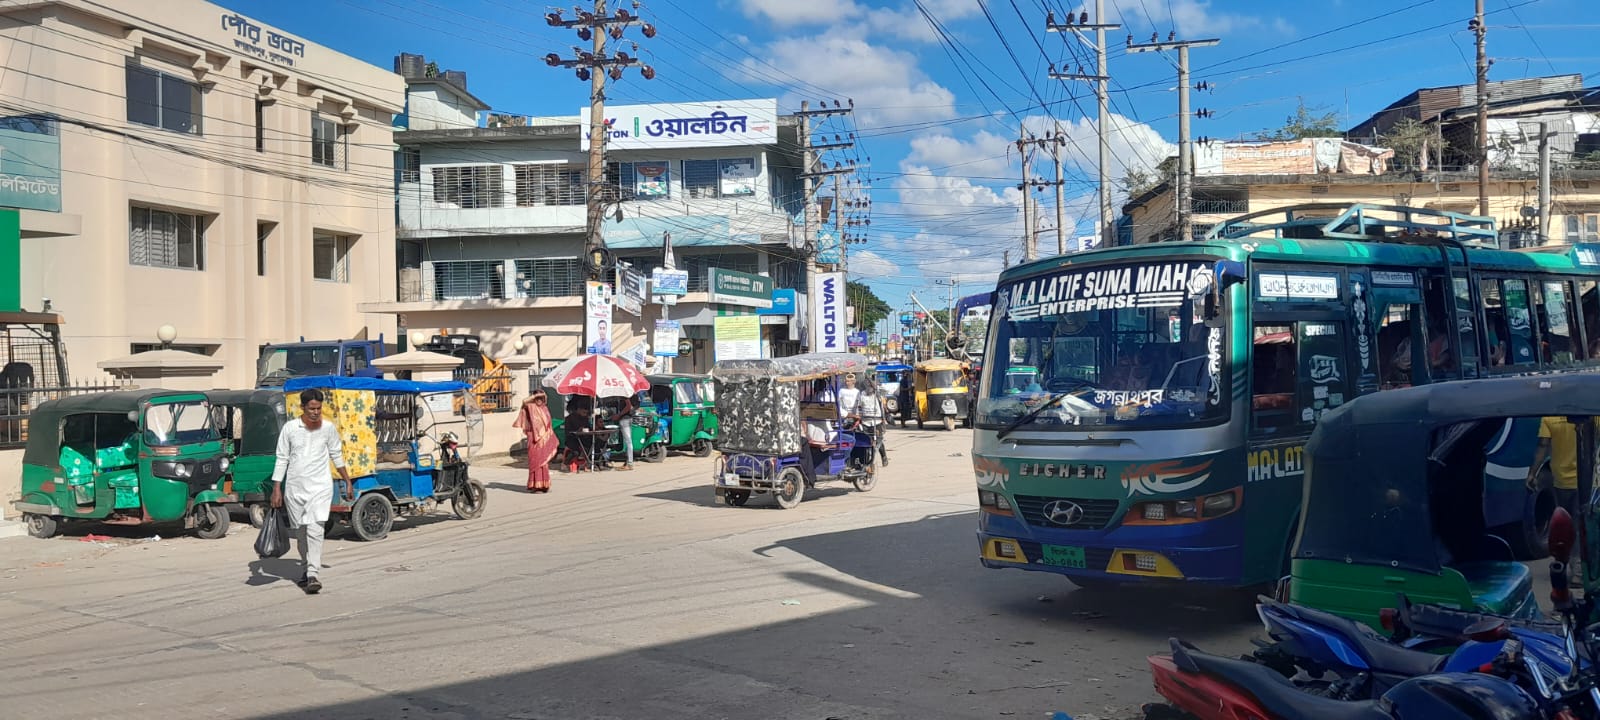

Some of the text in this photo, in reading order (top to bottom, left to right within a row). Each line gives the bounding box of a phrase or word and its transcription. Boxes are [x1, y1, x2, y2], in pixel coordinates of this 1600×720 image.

[222, 14, 305, 58] পৌর ভবন
[645, 111, 748, 138] ওয়ালটন
[752, 280, 764, 294] ATM
[1039, 270, 1082, 302] LATIF
[1083, 268, 1131, 298] SUNA
[1135, 263, 1189, 294] MIAH
[823, 277, 836, 348] WALTON
[1039, 294, 1137, 316] ENTERPRISE
[1306, 324, 1337, 337] SPECIAL
[1093, 389, 1165, 409] জগন্নাথপুর
[1019, 463, 1107, 480] EICHER
